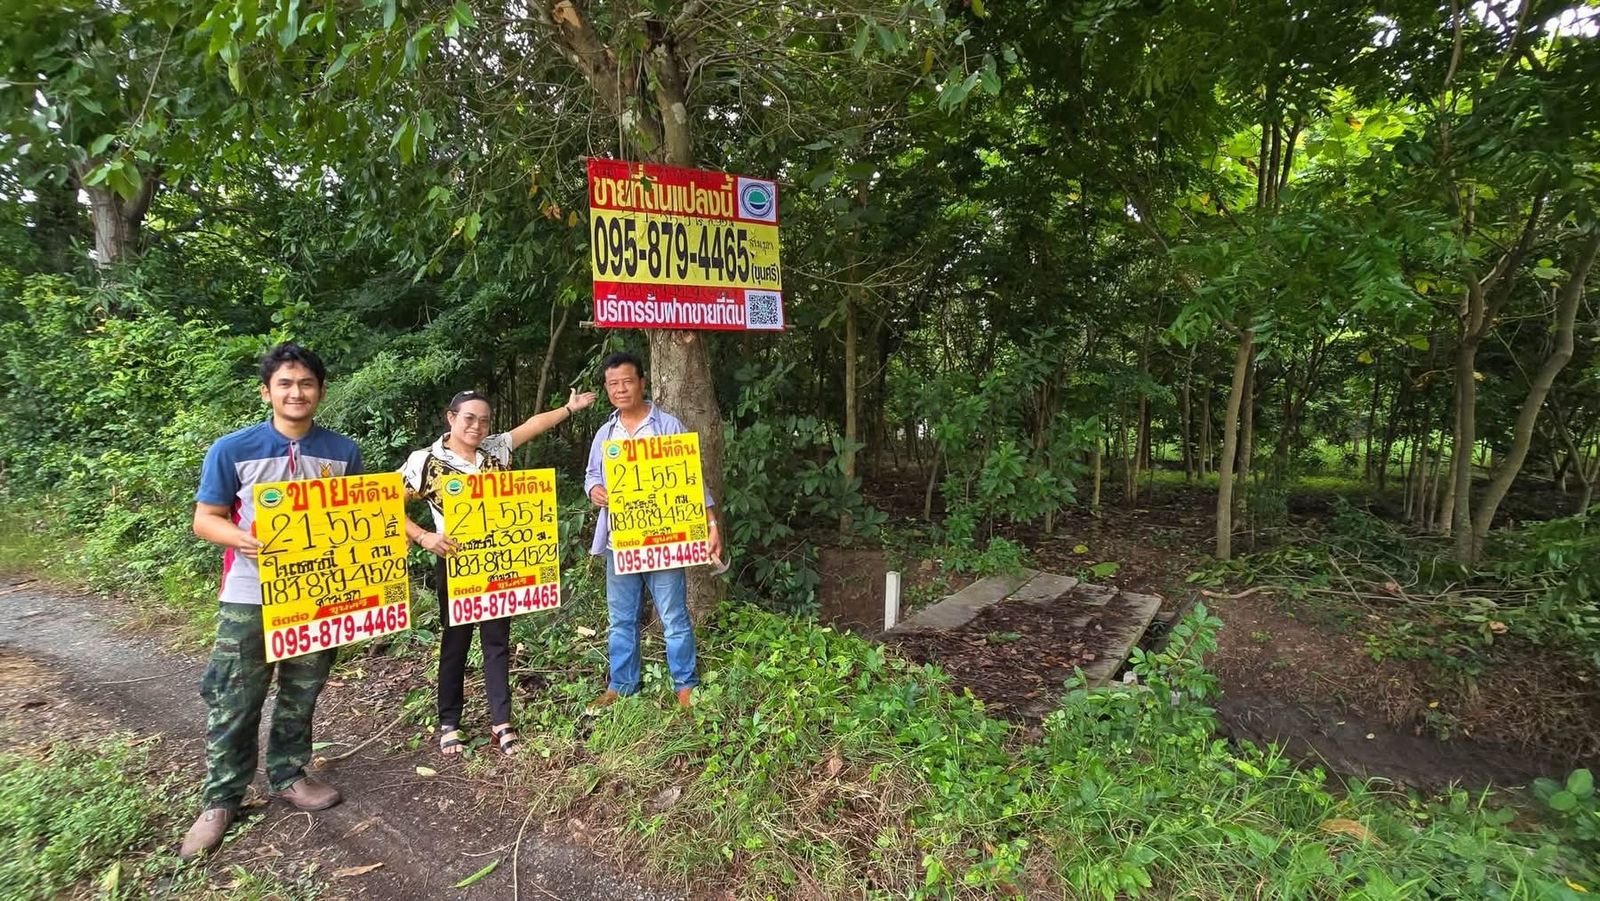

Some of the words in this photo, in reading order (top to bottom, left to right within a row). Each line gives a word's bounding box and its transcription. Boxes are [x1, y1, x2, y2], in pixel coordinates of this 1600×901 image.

[594, 215, 750, 283] 095-879-4465
[596, 293, 744, 325] บริการรับฝากขายที่ดิน
[623, 436, 696, 462] ขายที่ดิน
[287, 477, 399, 511] ขายที่ดิน
[467, 472, 553, 499] ขายที่ดิน
[499, 529, 533, 547] 300
[617, 538, 640, 548] ติดต่อ
[617, 541, 707, 572] 095-879-4465
[453, 584, 559, 623] 095-879-4465
[454, 584, 482, 596] ติดต่อ
[271, 603, 408, 659] 095-879-4465
[272, 612, 309, 627] ติดต่อ
